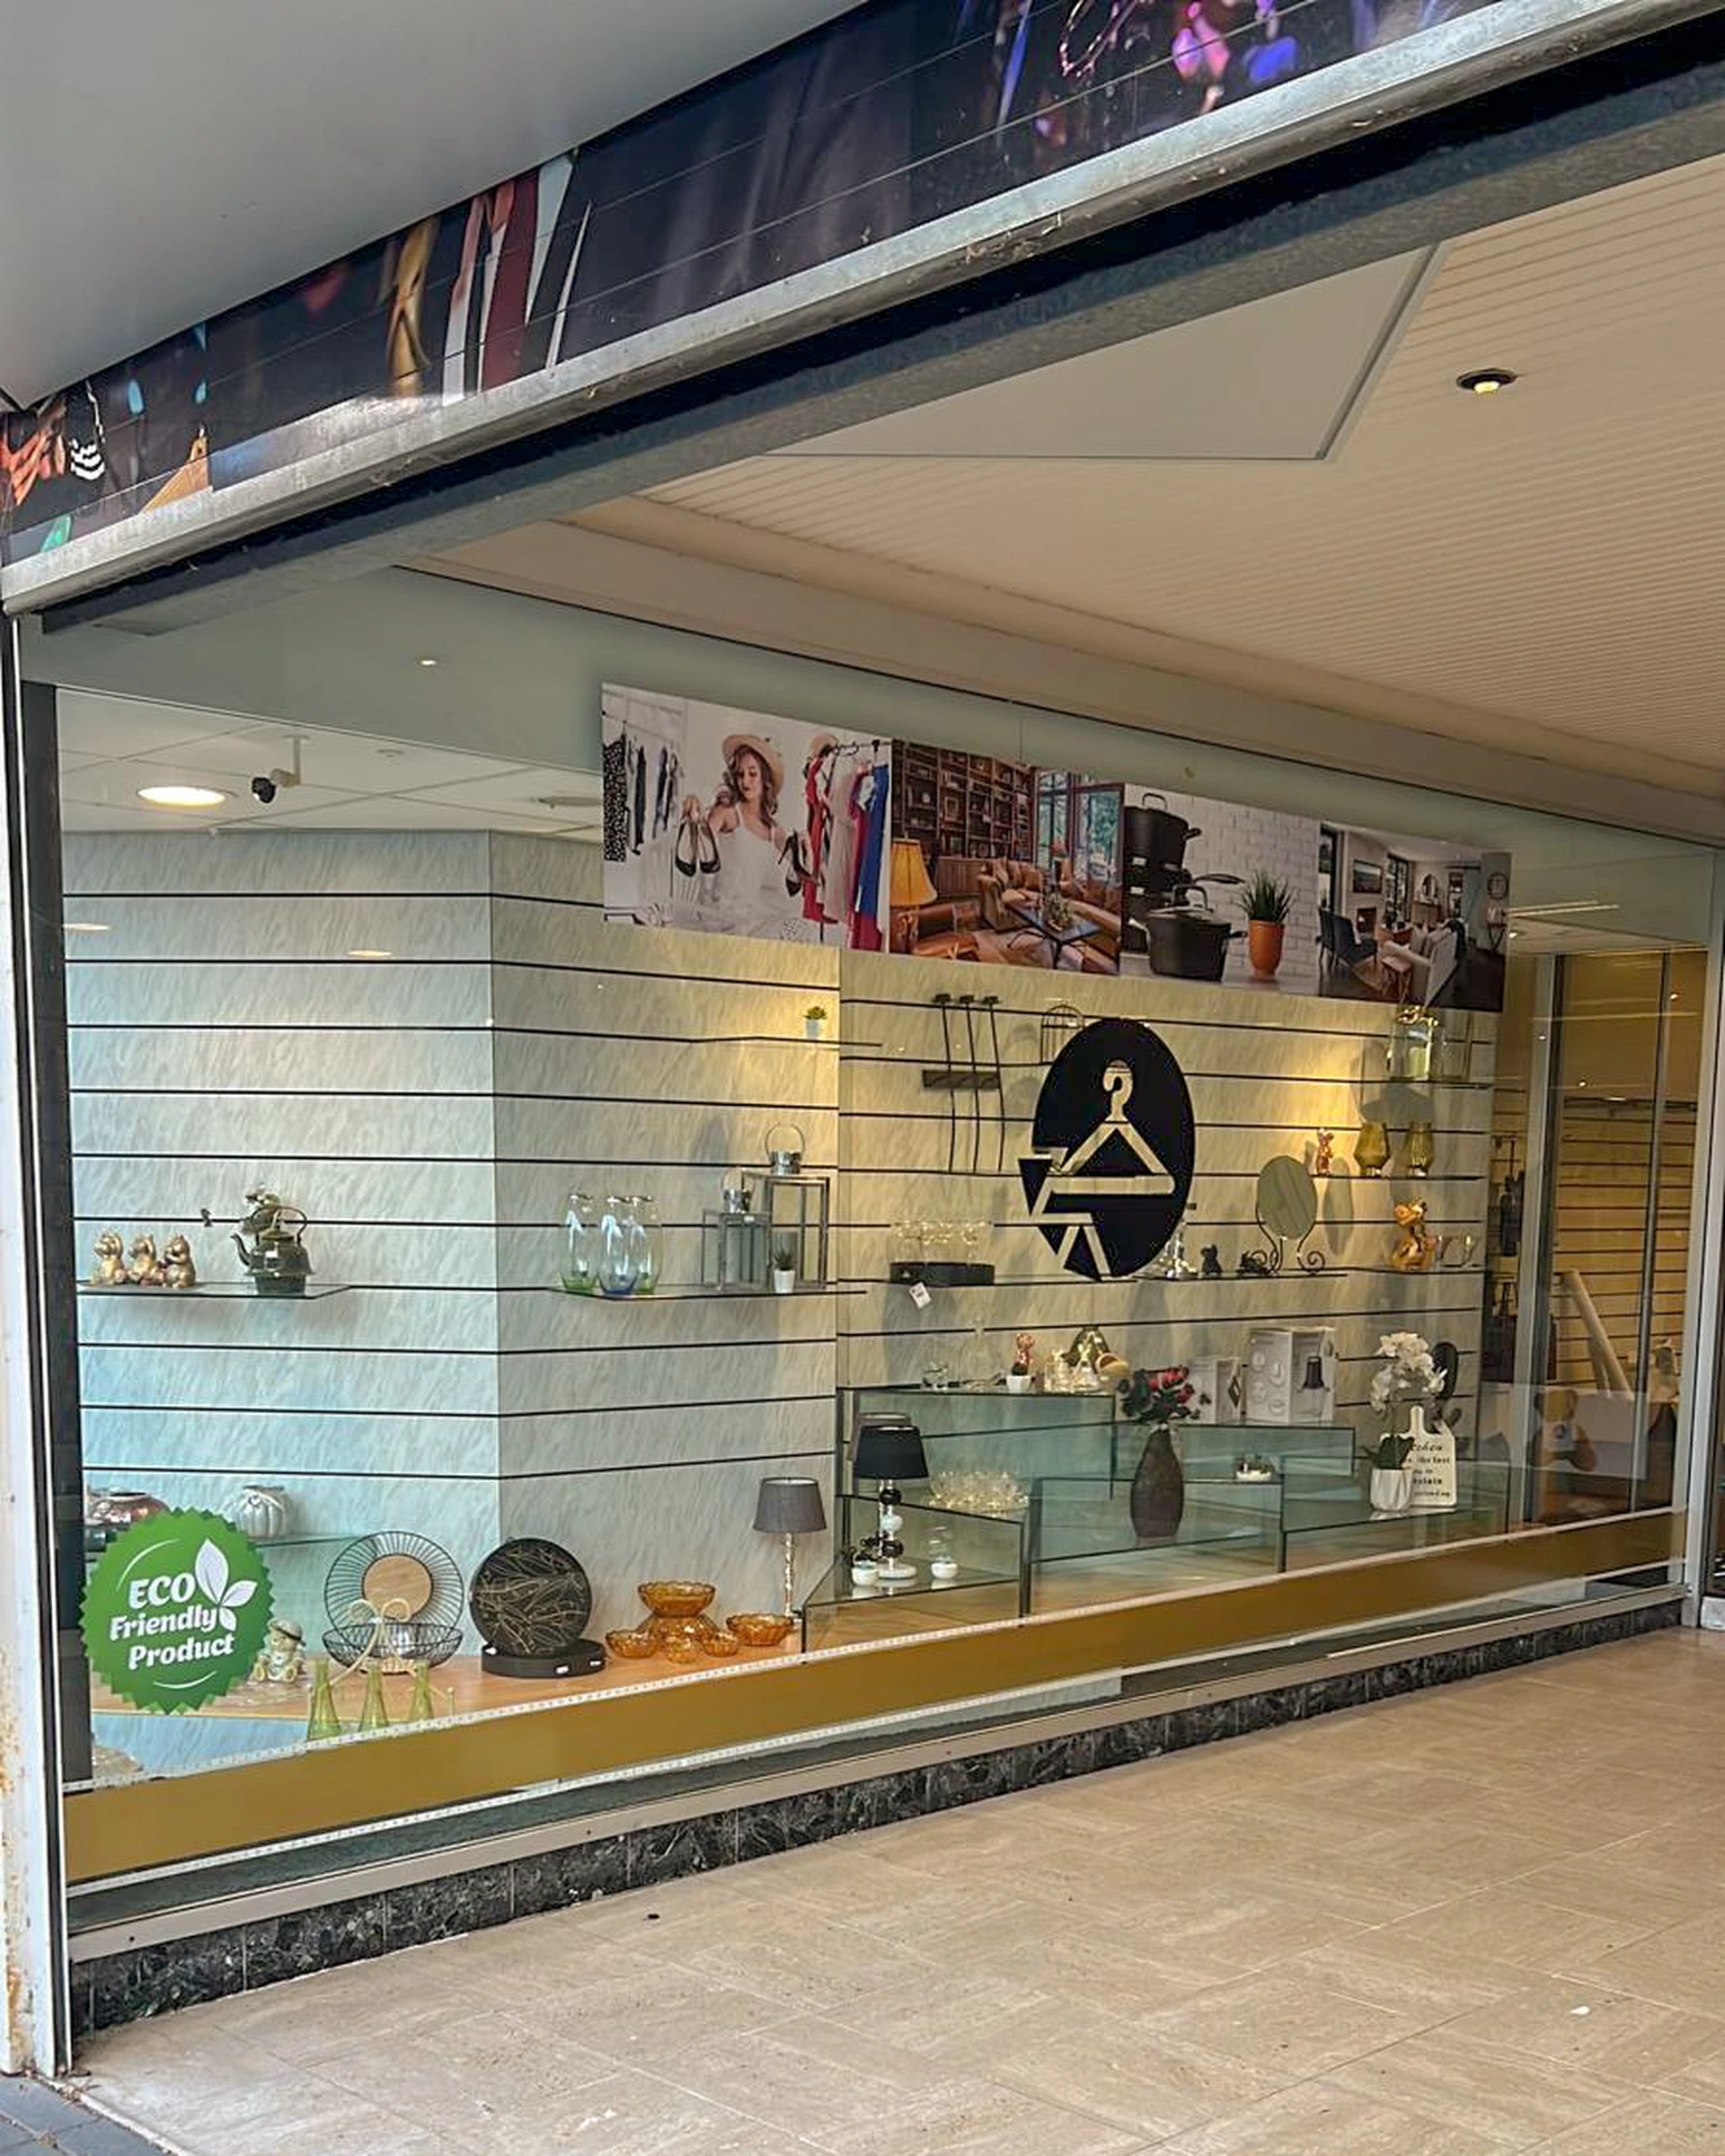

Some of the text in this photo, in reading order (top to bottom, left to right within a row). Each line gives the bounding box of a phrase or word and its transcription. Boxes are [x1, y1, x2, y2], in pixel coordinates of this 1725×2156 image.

[128, 1572, 196, 1610] ECO
[110, 1604, 217, 1642] Friendly
[128, 1632, 235, 1671] Product
